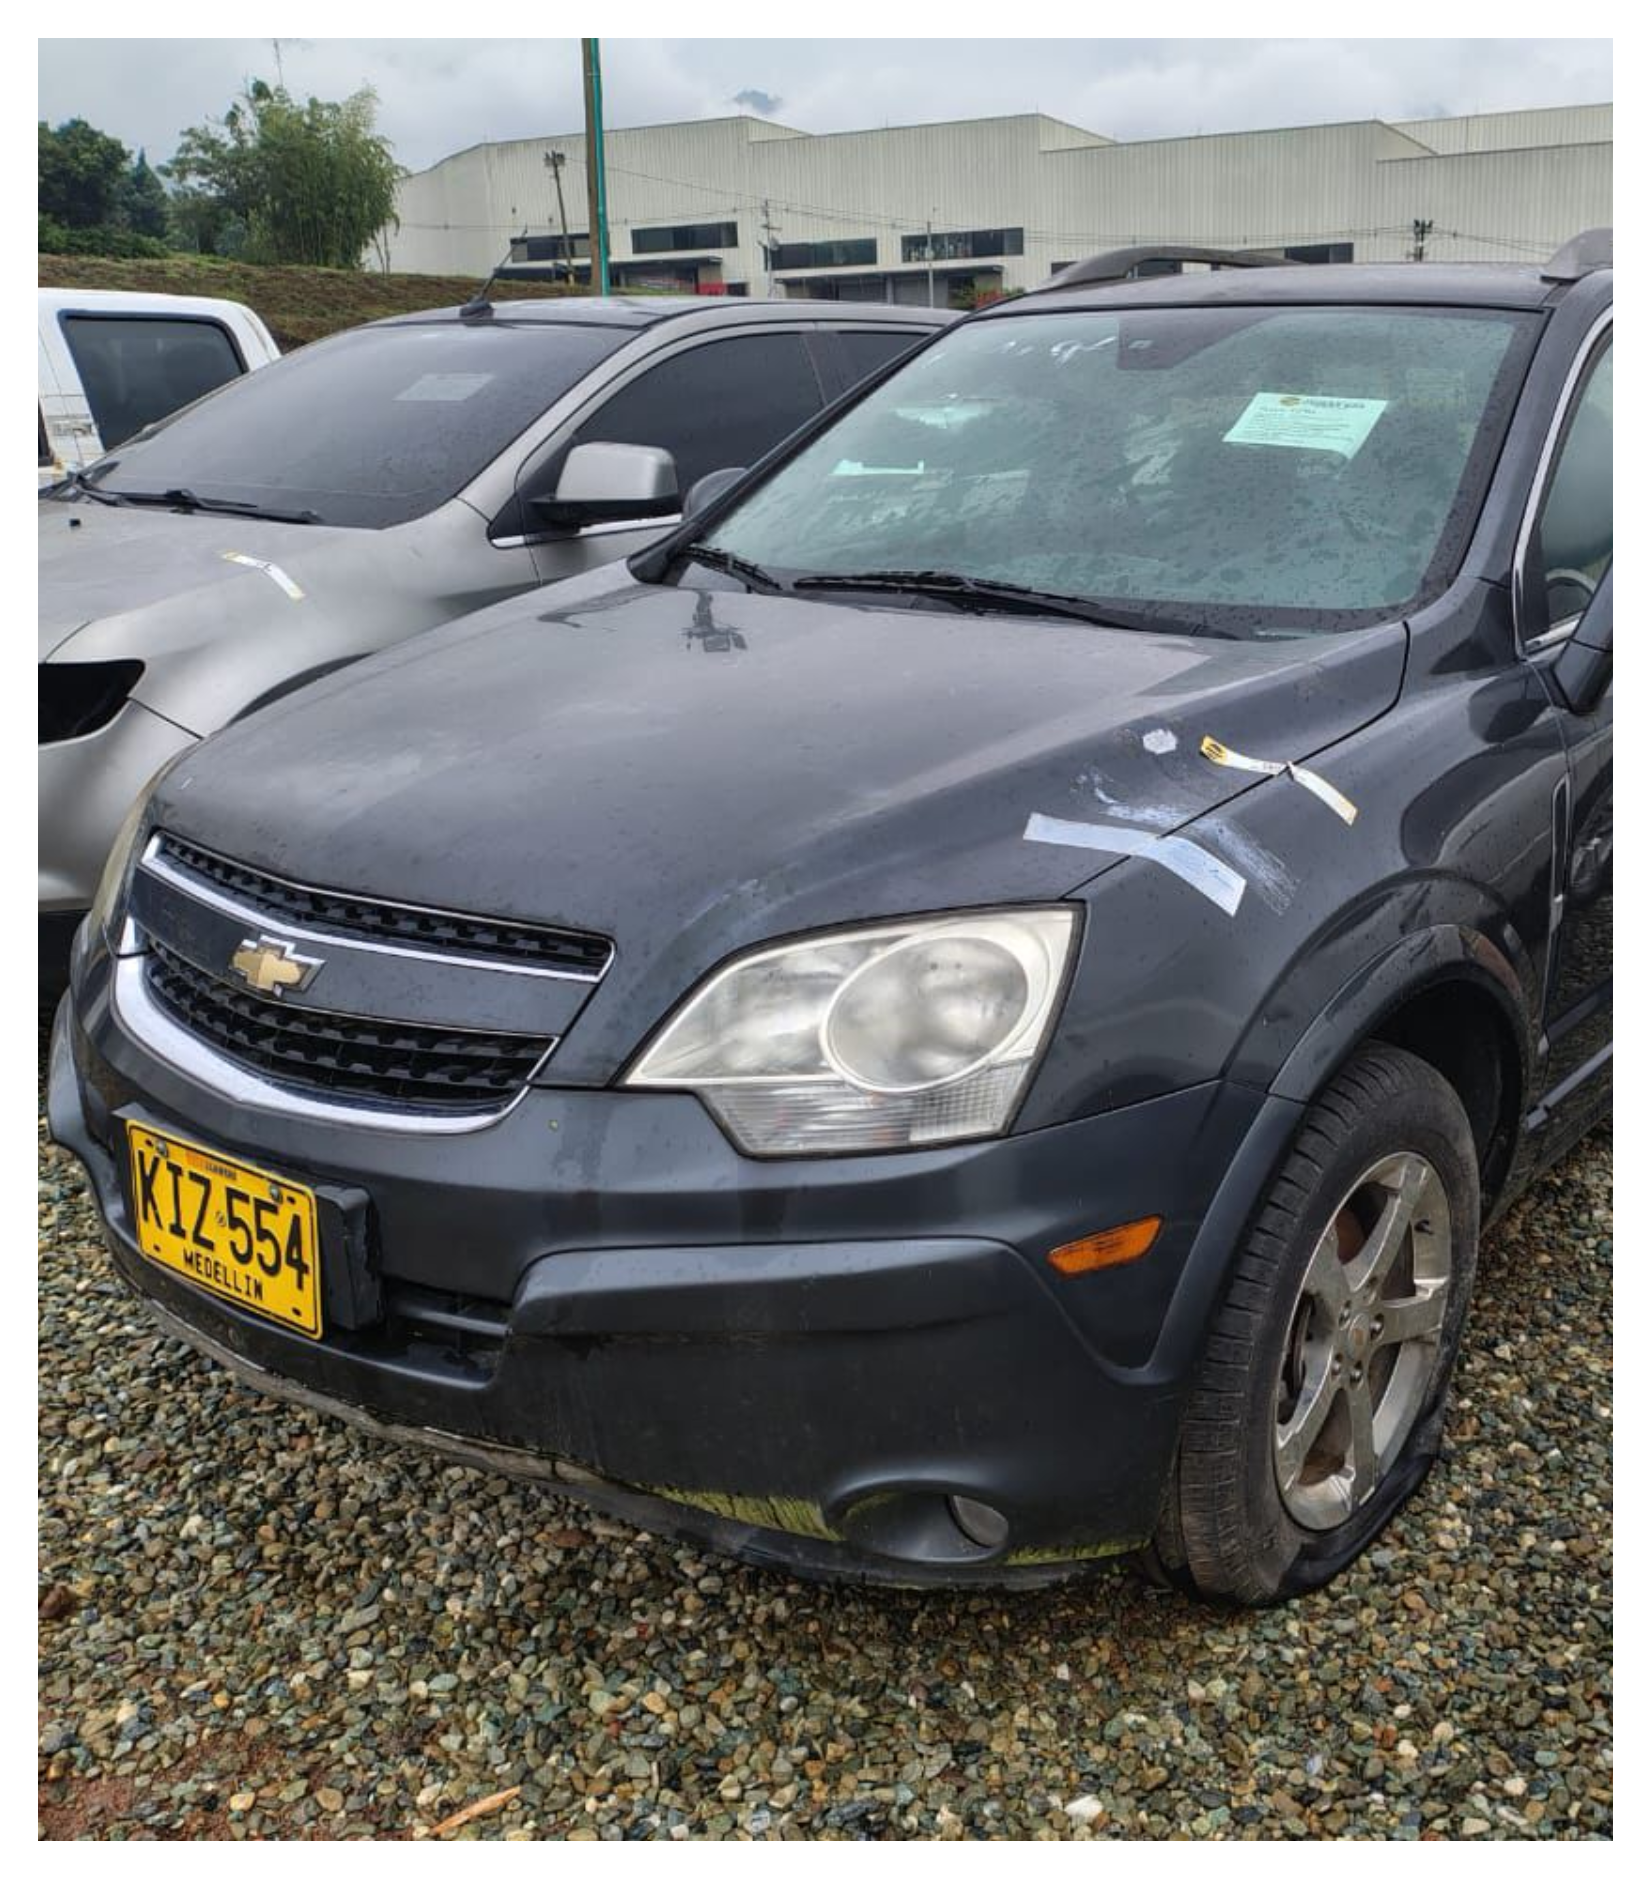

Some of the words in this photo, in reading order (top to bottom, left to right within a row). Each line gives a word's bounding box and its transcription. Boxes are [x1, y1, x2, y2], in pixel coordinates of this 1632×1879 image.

[138, 1150, 215, 1251] KIZ
[225, 1187, 309, 1290] 554
[183, 1248, 263, 1300] MEDELLIN
